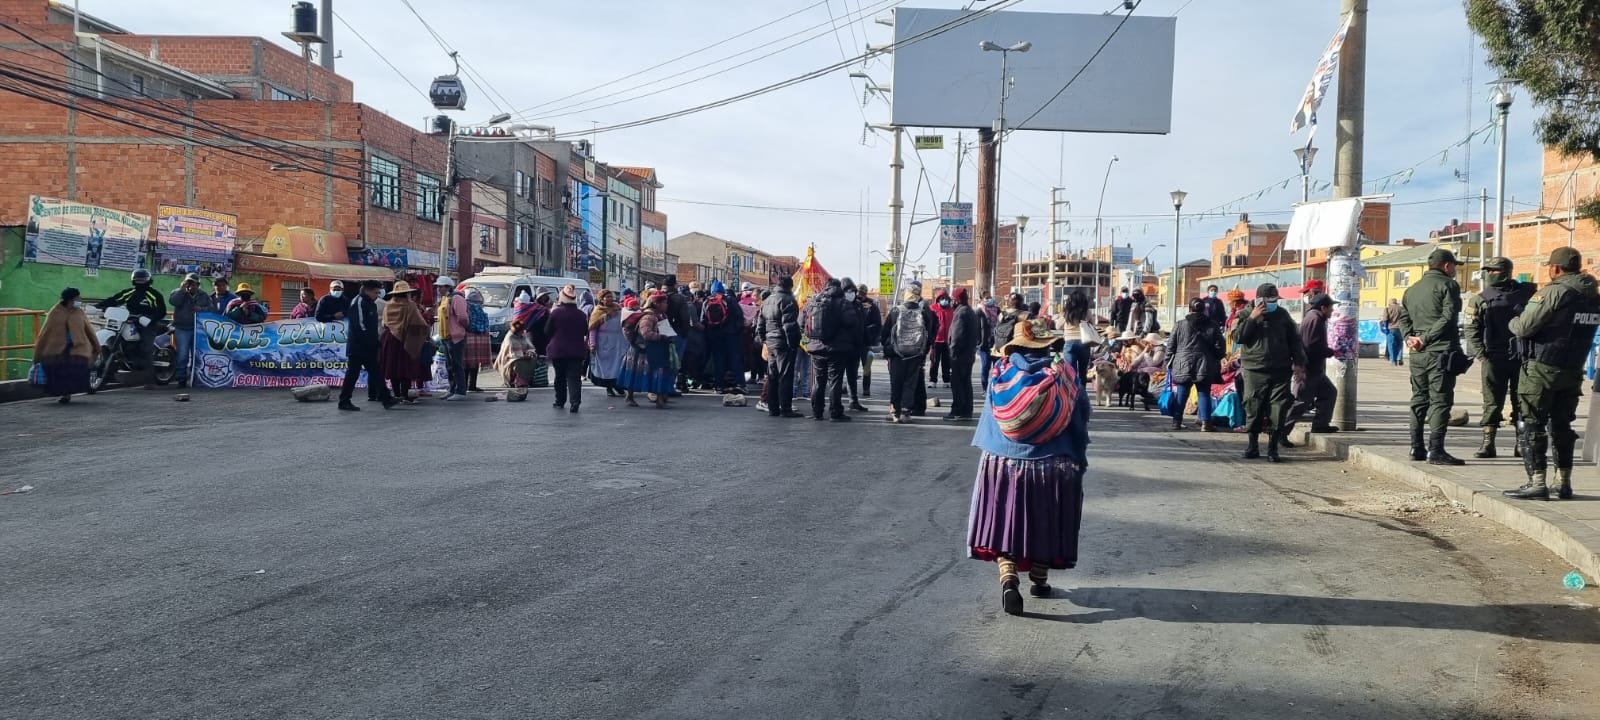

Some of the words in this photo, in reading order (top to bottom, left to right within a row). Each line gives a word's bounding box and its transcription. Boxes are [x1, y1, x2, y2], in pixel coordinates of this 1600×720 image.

[40, 205, 61, 217] CENTRO
[62, 205, 69, 215] DE
[70, 205, 92, 215] MEDICINA
[93, 207, 120, 222] TRADICIONAL
[1573, 312, 1600, 324] POLIC
[203, 320, 270, 351] U.E.
[278, 321, 347, 347] TAR
[249, 361, 278, 369] FUND.
[280, 361, 293, 369] EL
[295, 361, 307, 369] 20
[309, 361, 322, 369] DE
[263, 375, 298, 387] VALOR
[301, 376, 309, 386] Y
